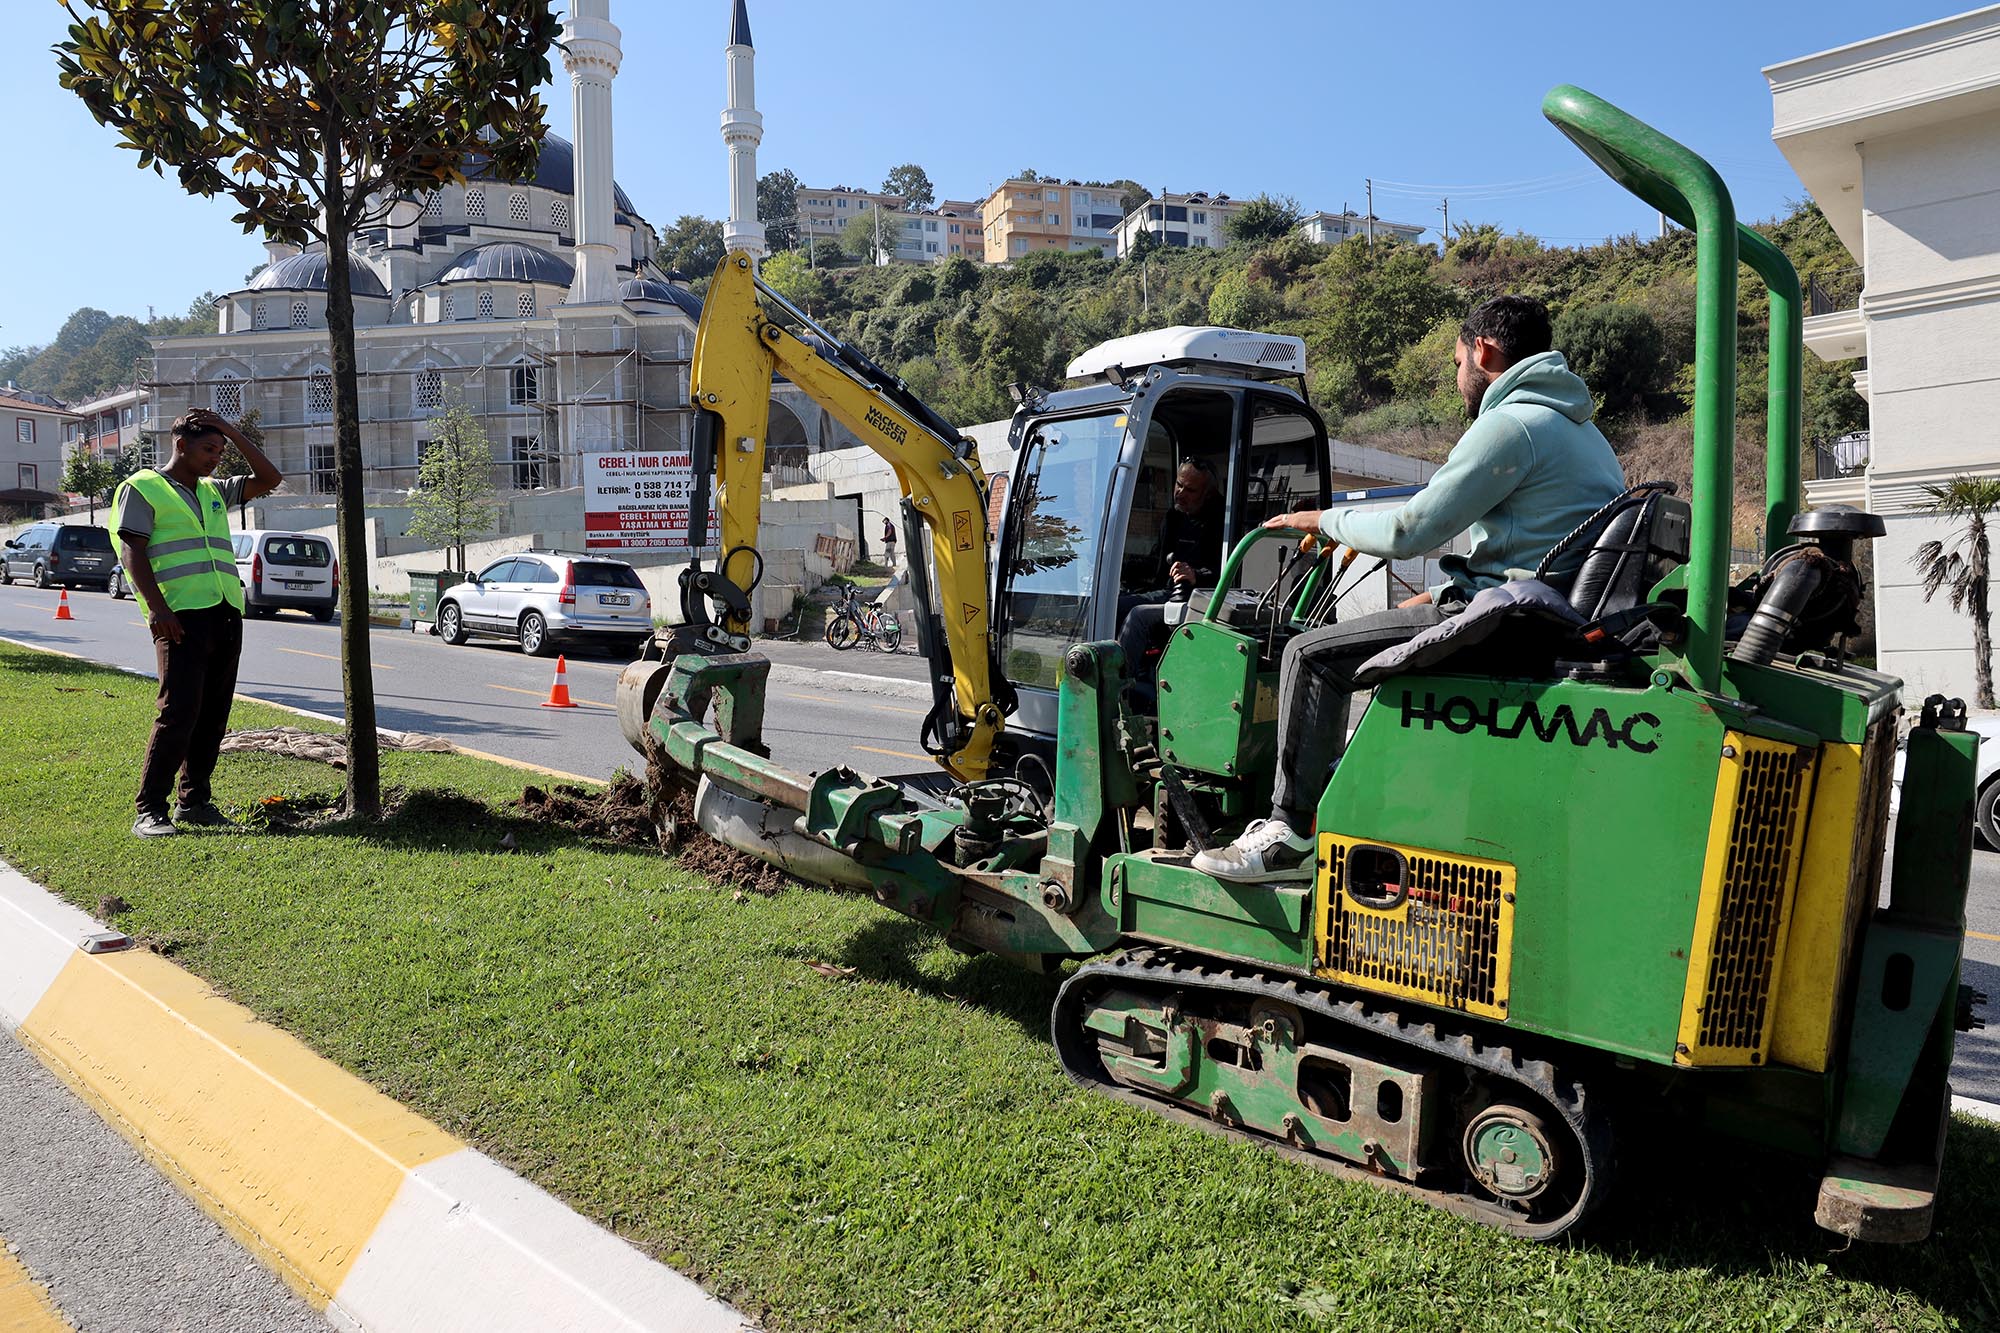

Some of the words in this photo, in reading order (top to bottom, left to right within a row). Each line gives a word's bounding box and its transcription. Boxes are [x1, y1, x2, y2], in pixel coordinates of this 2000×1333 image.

[869, 405, 907, 438] WACKER
[864, 413, 905, 445] NEUSON
[599, 455, 635, 468] CEBEL-İ
[638, 457, 659, 467] NUR
[665, 481, 682, 489] 714
[665, 490, 682, 498] 462
[620, 512, 649, 520] CEBEL-İ
[651, 512, 668, 520] NUR
[621, 521, 659, 529] YAŞATMA
[621, 539, 630, 547] TR
[1400, 690, 1661, 754] HOLMAC
